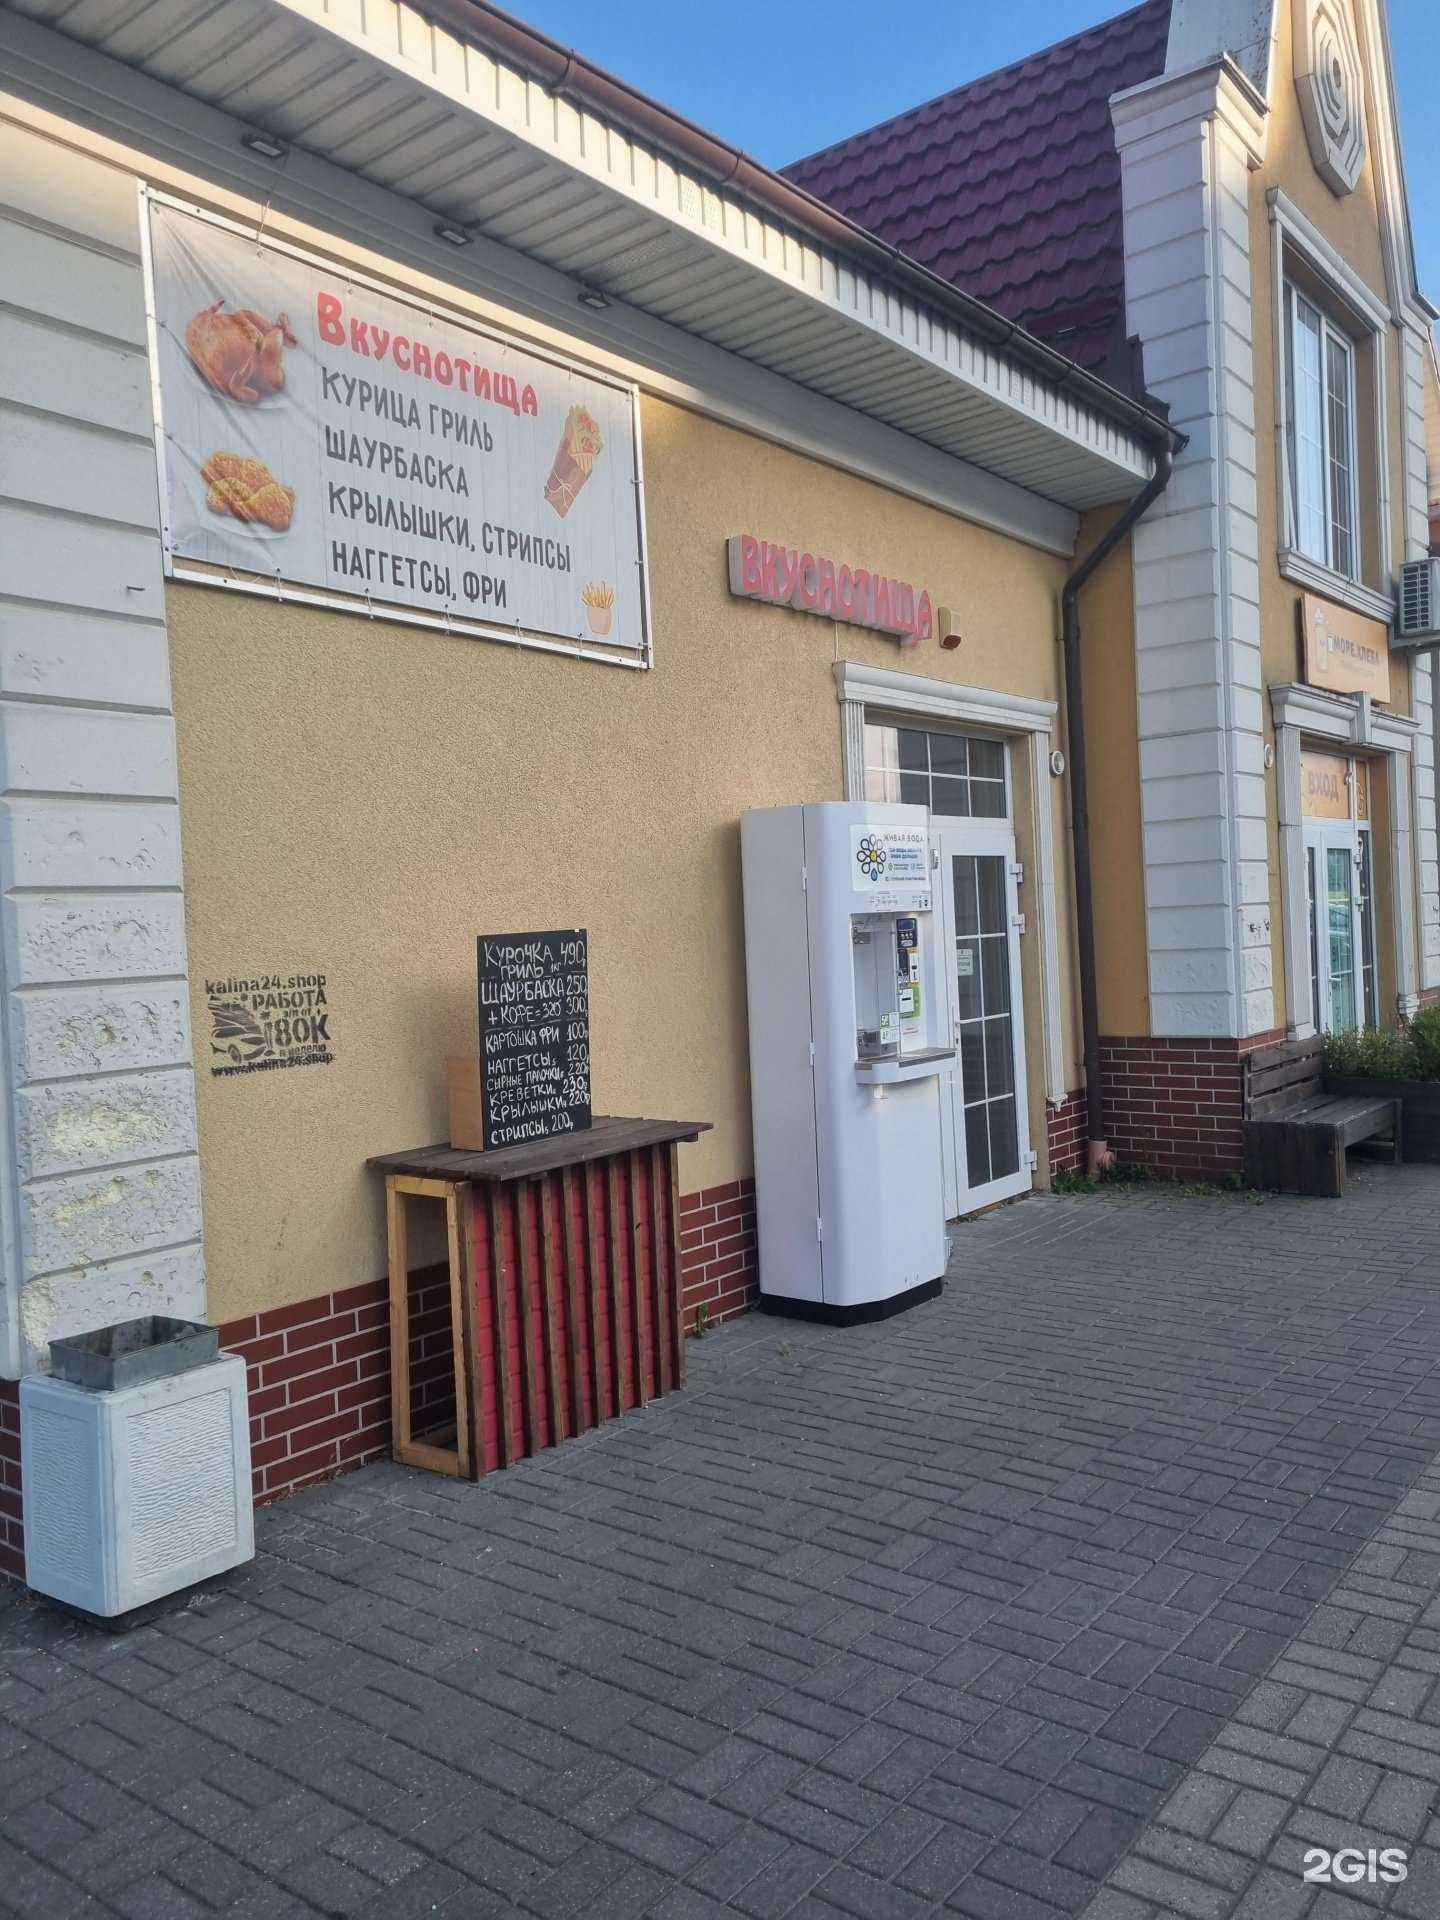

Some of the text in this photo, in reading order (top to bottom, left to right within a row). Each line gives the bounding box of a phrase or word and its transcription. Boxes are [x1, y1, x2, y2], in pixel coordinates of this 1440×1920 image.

[321, 367, 494, 452] КУРИЦА ГРИЛЬ
[325, 425, 469, 497] ШАУРБАСКА
[329, 481, 571, 573] КРЫЛЫШКИ, СТРИПСЫ
[331, 540, 507, 609] НАГГЕТСЫ, ФРИ
[742, 534, 933, 648] ВКУСНОТИЩА
[1307, 766, 1339, 803] ВХОД
[484, 941, 554, 968] КУРОЧКА
[205, 974, 327, 995] kalina24.shop
[500, 963, 544, 980] ГРИЛЬ
[252, 988, 327, 1011] РАБОТА
[485, 1029, 537, 1054] КАРТОШКА
[539, 1026, 560, 1045] ФРИ
[486, 1074, 523, 1091] СЫРНЫЕ
